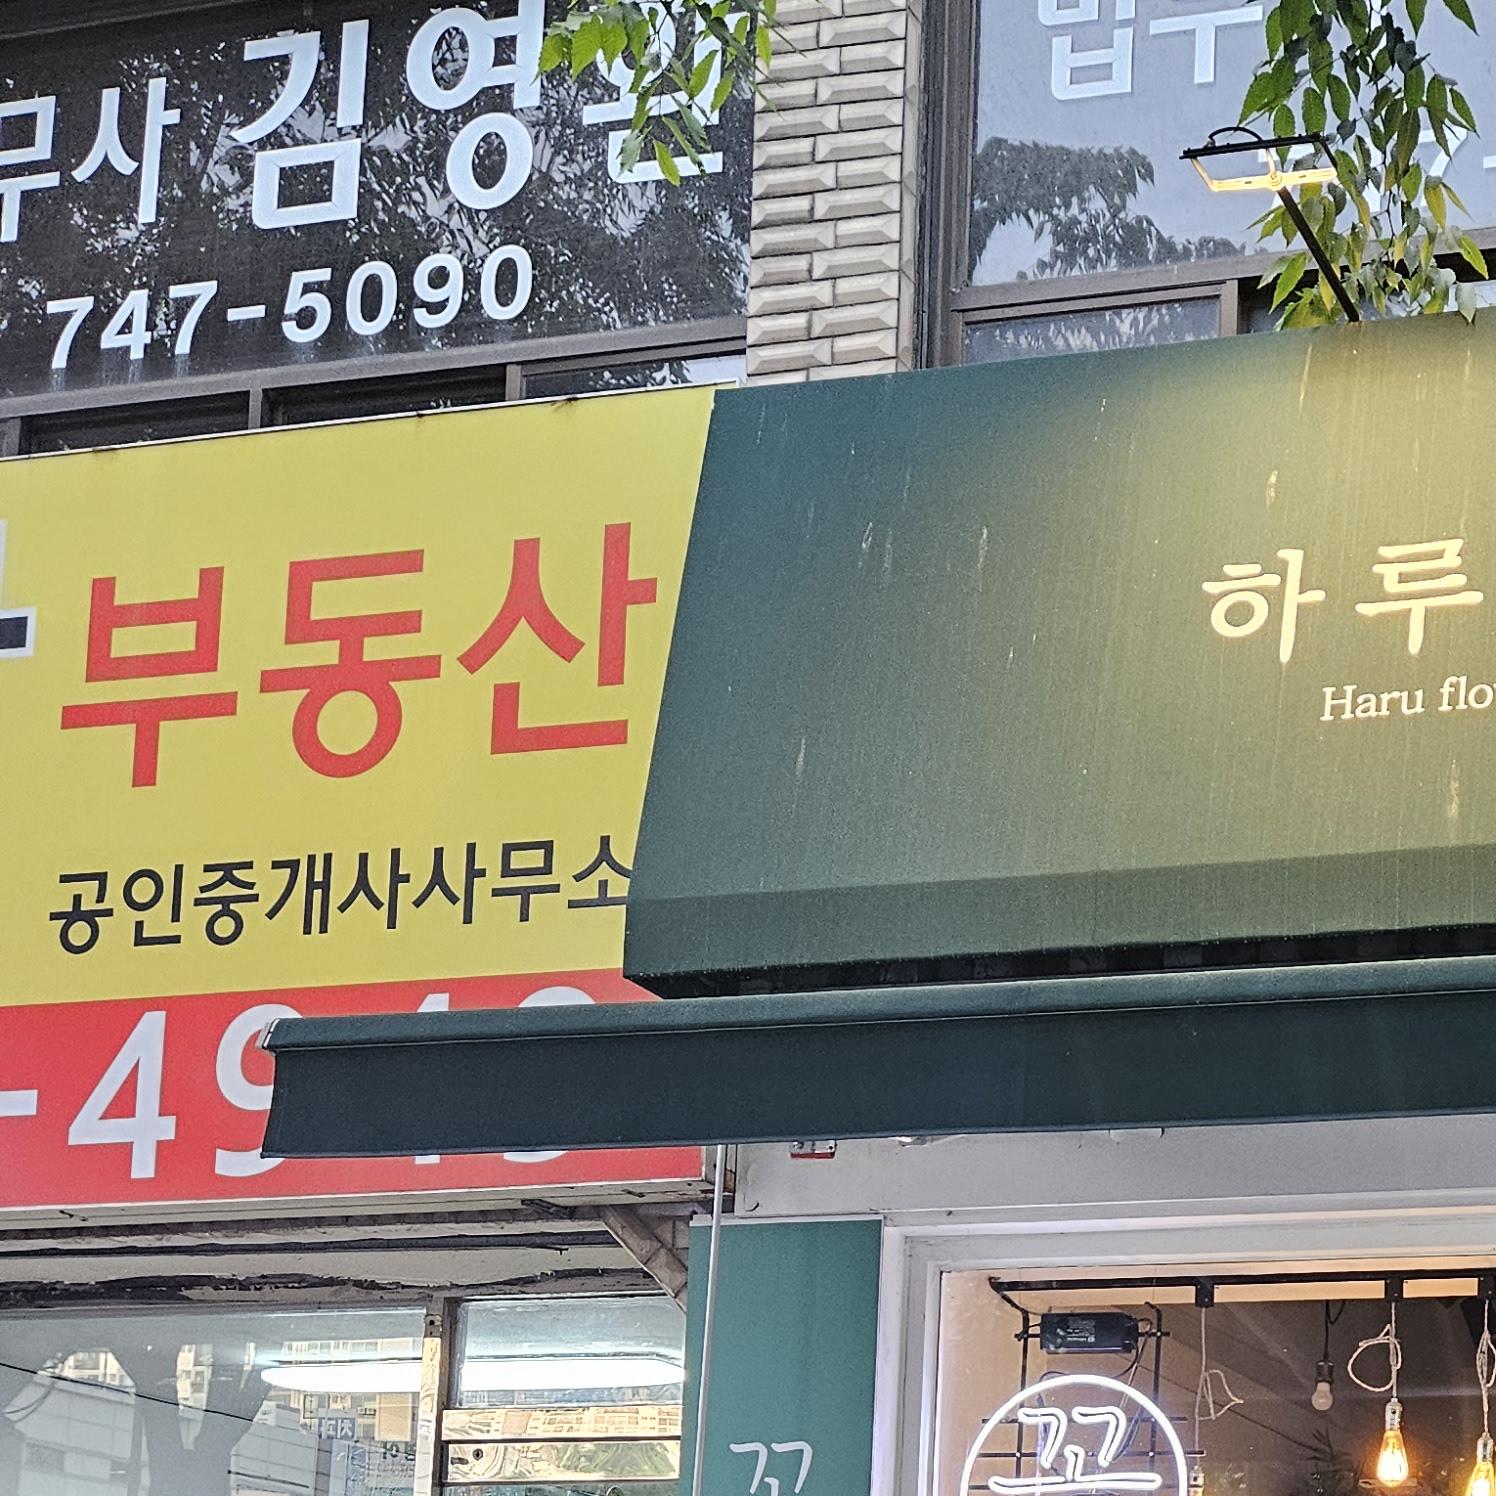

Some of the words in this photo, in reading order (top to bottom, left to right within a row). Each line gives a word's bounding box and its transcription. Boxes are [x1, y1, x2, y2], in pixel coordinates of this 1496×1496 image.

[46, 244, 534, 371] 747-5090
[60, 522, 658, 788] 부동산
[1320, 686, 1425, 721] Haru
[49, 834, 633, 954] 공인중개사사무소
